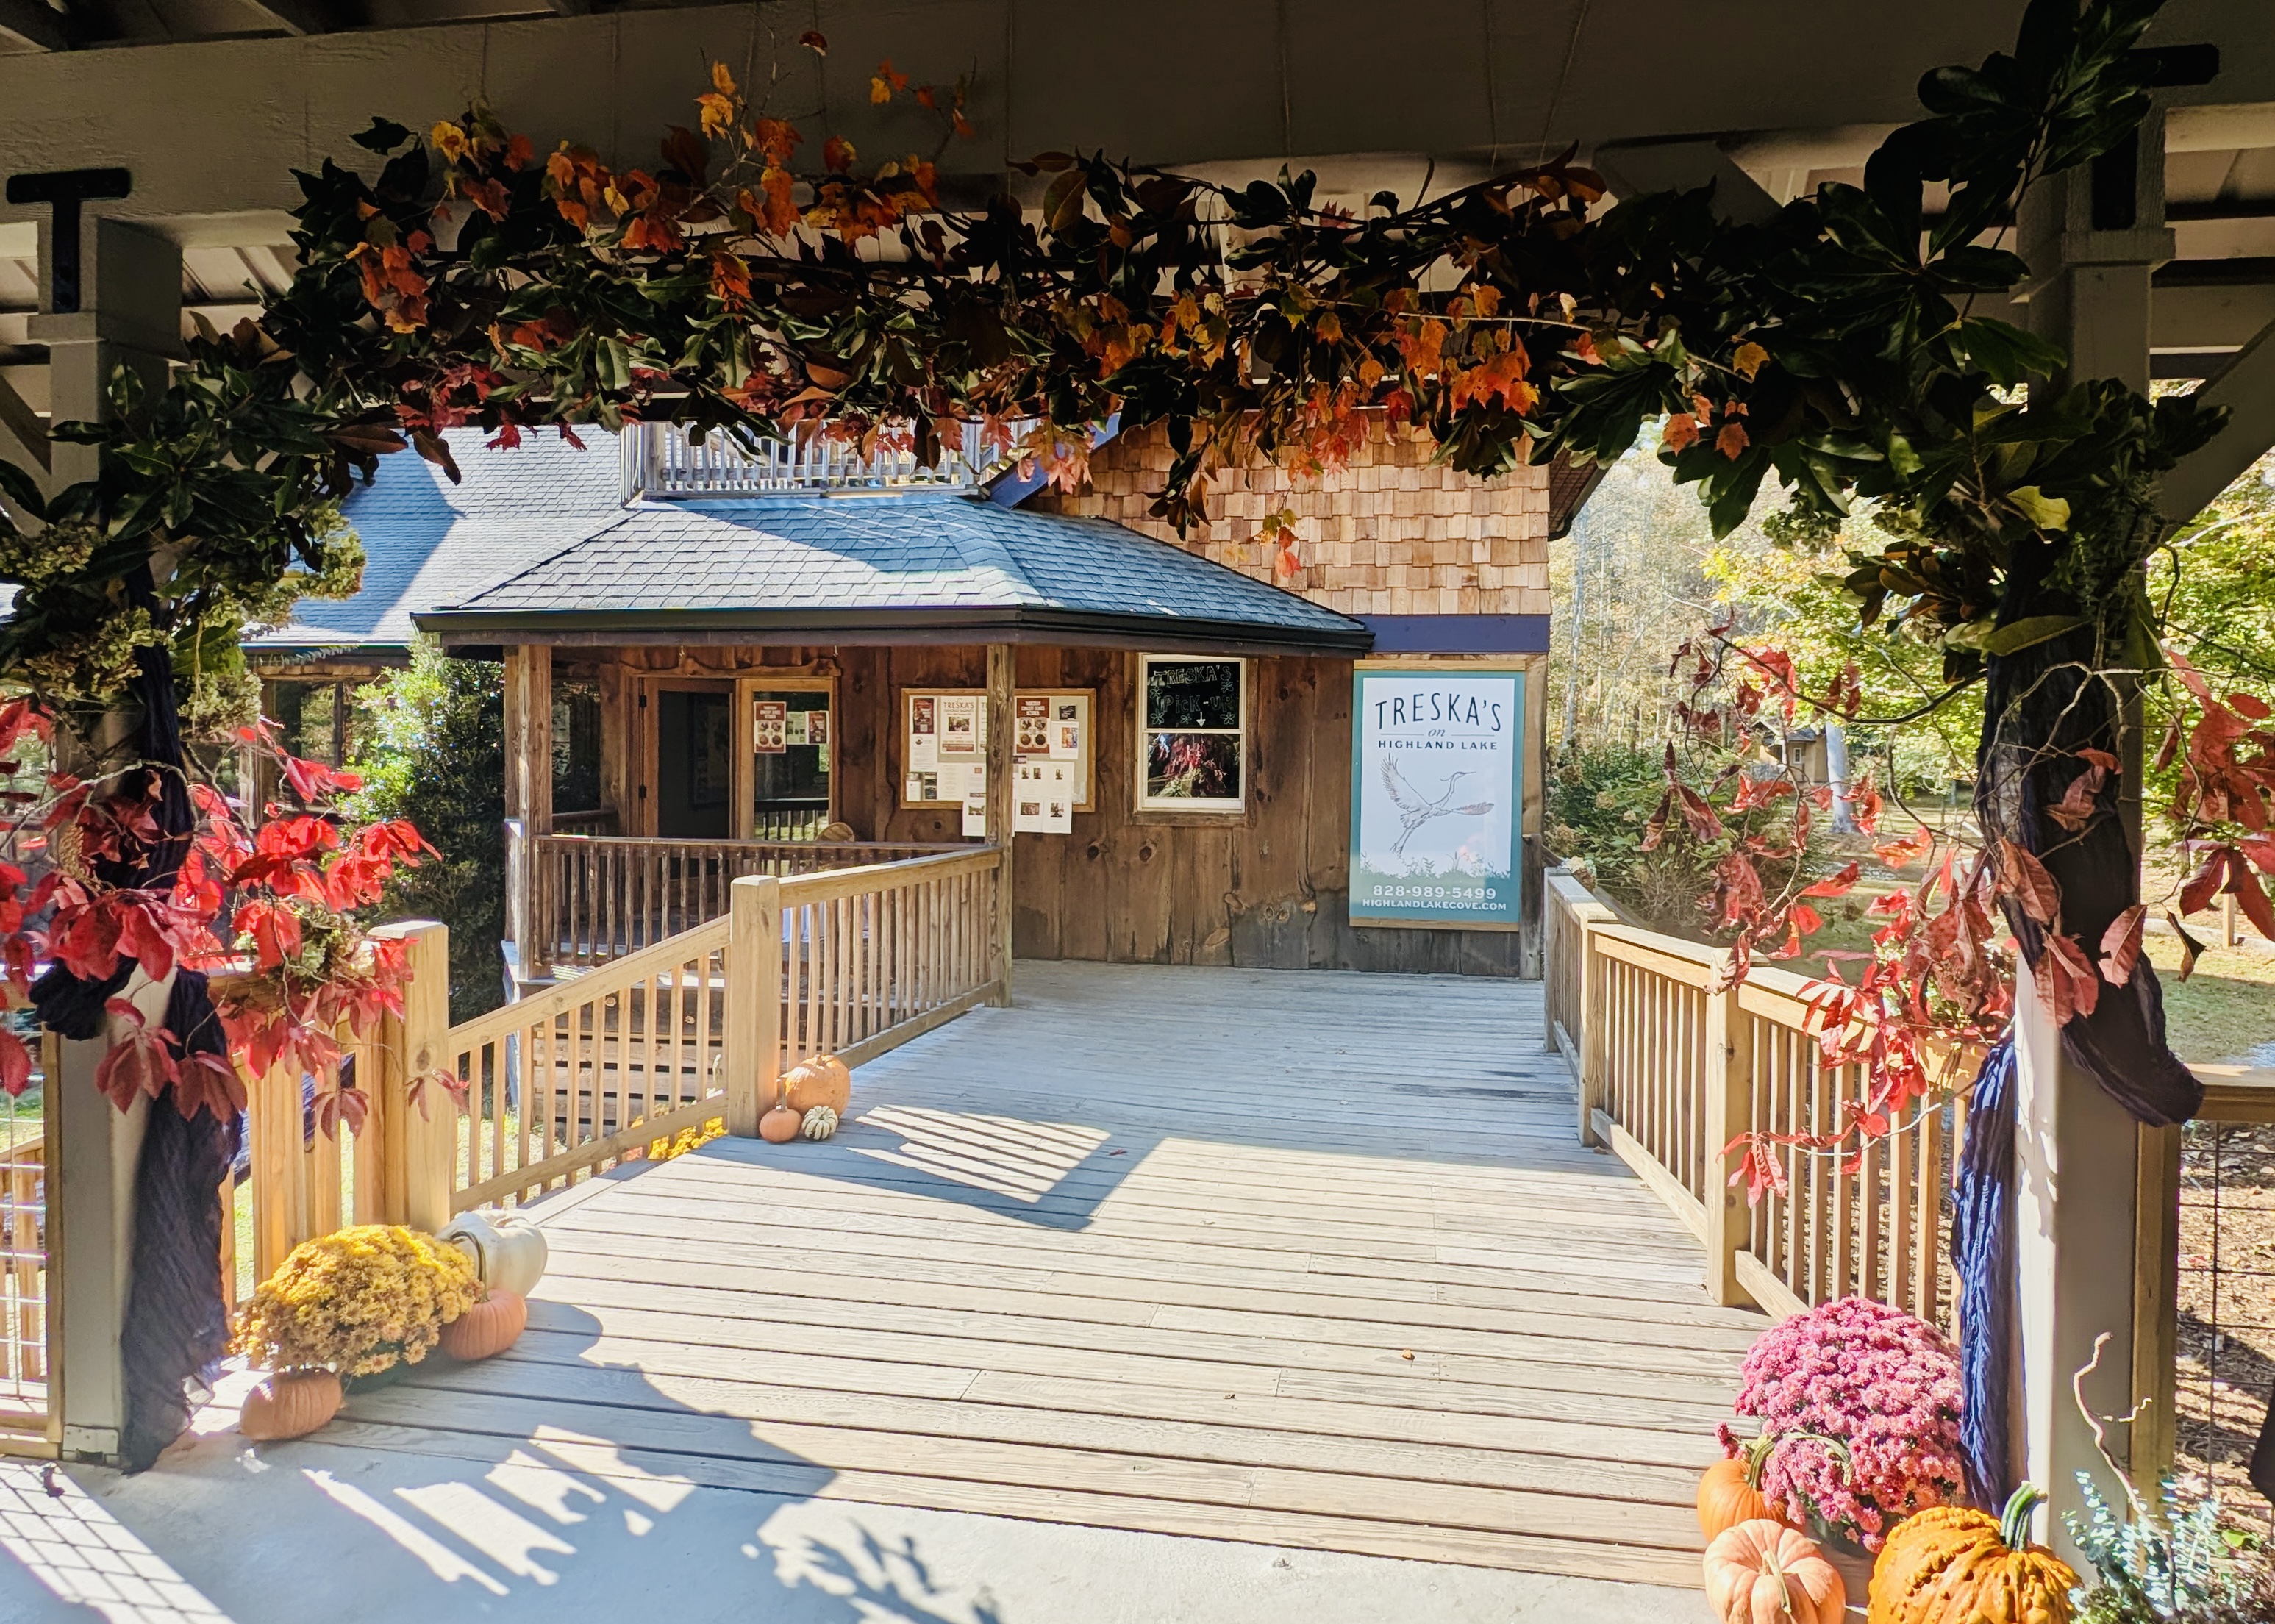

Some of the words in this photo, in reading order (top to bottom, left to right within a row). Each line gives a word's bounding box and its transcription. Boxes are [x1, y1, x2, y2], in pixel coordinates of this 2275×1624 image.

[1153, 664, 1232, 685] TRESKA'S
[1375, 693, 1501, 731] TRESKA'S
[1428, 729, 1446, 737] on
[1379, 740, 1454, 750] HIGHLAND
[1461, 742, 1498, 751] LAKE
[1373, 884, 1497, 900] 828-989-5499
[1362, 899, 1507, 911] HIGHLANDLAKECOVE.COM
